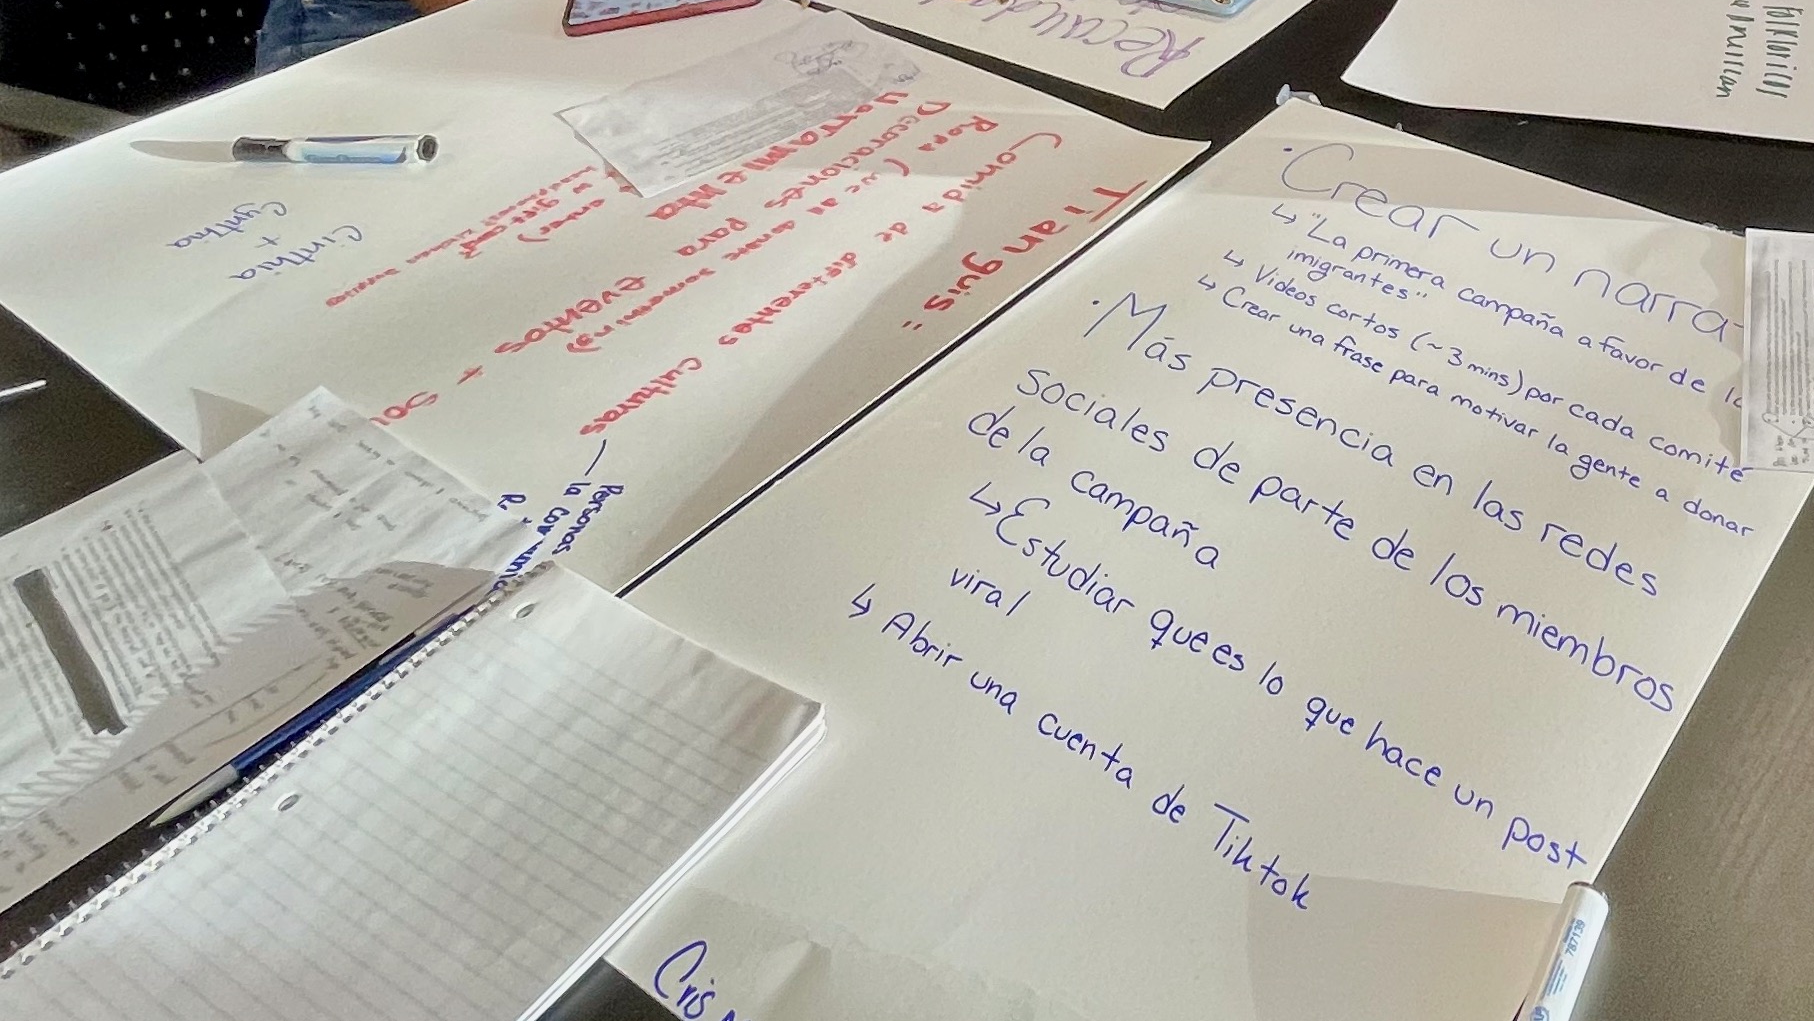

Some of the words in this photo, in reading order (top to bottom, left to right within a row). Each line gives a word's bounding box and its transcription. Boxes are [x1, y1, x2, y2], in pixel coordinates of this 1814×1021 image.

[874, 220, 909, 244] de
[921, 131, 1063, 214] Comida
[1281, 143, 1481, 240] Crear
[1488, 231, 1557, 274] un
[1572, 264, 1744, 345] narra
[1326, 296, 1400, 343] cortos
[1523, 385, 1565, 422] por
[1568, 400, 1636, 441] cada
[1351, 238, 1447, 291] primera
[1457, 285, 1565, 341] campaña
[1668, 364, 1708, 396] de
[967, 404, 1017, 449] de
[1016, 425, 1051, 467] la
[1069, 468, 1223, 571] campaña
[1221, 283, 1282, 324] Crear
[1288, 324, 1327, 350] una
[1333, 333, 1384, 376] frase
[1390, 363, 1442, 402] para
[1449, 388, 1540, 441] motivar
[1548, 425, 1570, 457] la
[1569, 447, 1642, 493] gente
[1653, 486, 1670, 503] a
[1681, 494, 1757, 539] donar
[948, 567, 1033, 617] viral
[1192, 440, 1242, 485] de
[1248, 474, 1356, 543] parte
[1369, 527, 1416, 572] de
[1433, 551, 1488, 609] los
[1493, 599, 1677, 716] miembros
[1411, 461, 1455, 497] en
[1471, 478, 1525, 534] las
[1540, 522, 1661, 599] redes
[880, 611, 964, 668] Abrir
[967, 672, 1022, 720] una
[1035, 711, 1136, 791] cuenta
[1149, 785, 1188, 828] de
[1257, 660, 1286, 696] lo
[1302, 692, 1357, 738] que
[1363, 718, 1445, 791] hace
[1452, 780, 1497, 822] un
[1499, 815, 1591, 873] post
